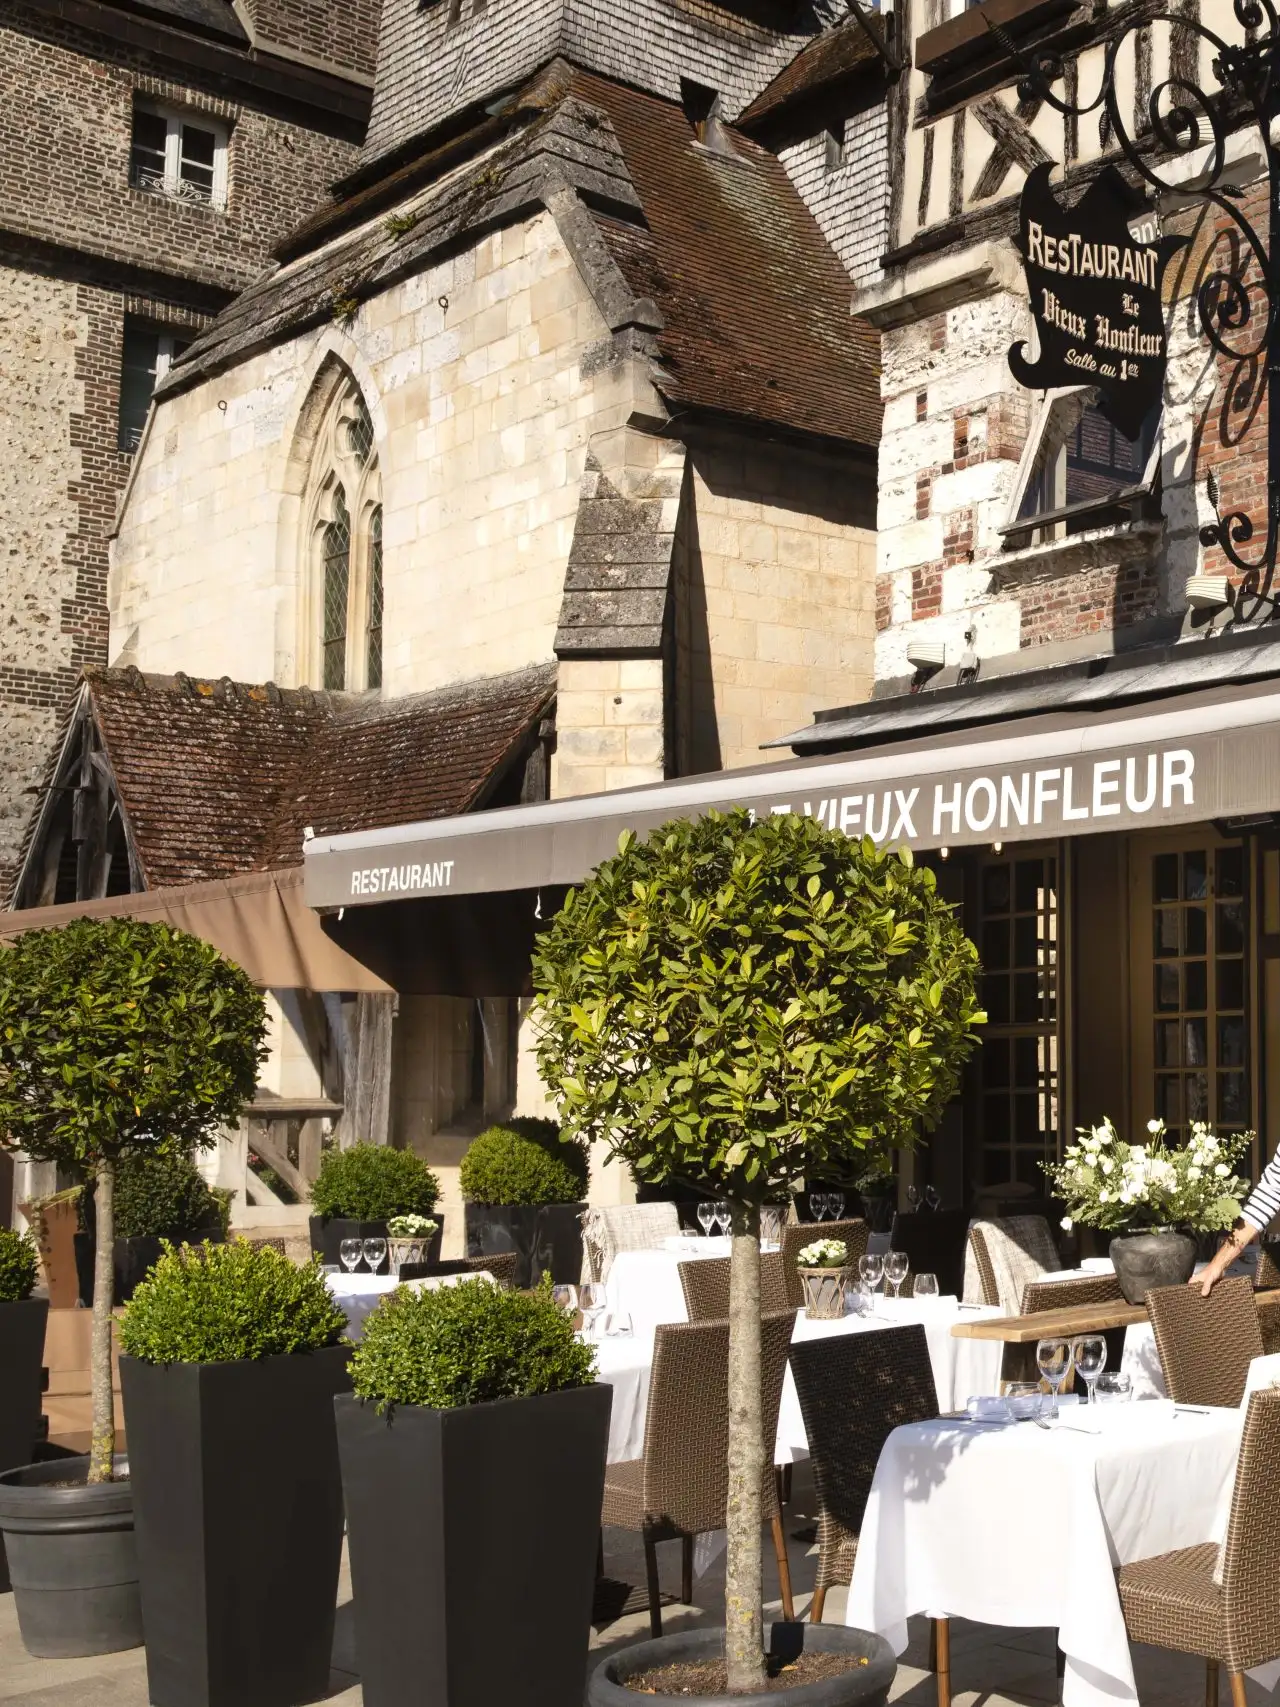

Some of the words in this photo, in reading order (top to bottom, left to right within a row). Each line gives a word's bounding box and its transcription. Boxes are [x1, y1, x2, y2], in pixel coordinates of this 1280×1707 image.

[1027, 219, 1159, 291] RESTAURANT
[1041, 288, 1087, 341] Vieux
[1094, 314, 1163, 357] Honfleur
[1121, 292, 1140, 317] Le
[1063, 348, 1098, 372] Salle
[1099, 363, 1117, 378] au
[932, 749, 1196, 836] HONFLEUR
[351, 860, 455, 895] RESTAURANT
